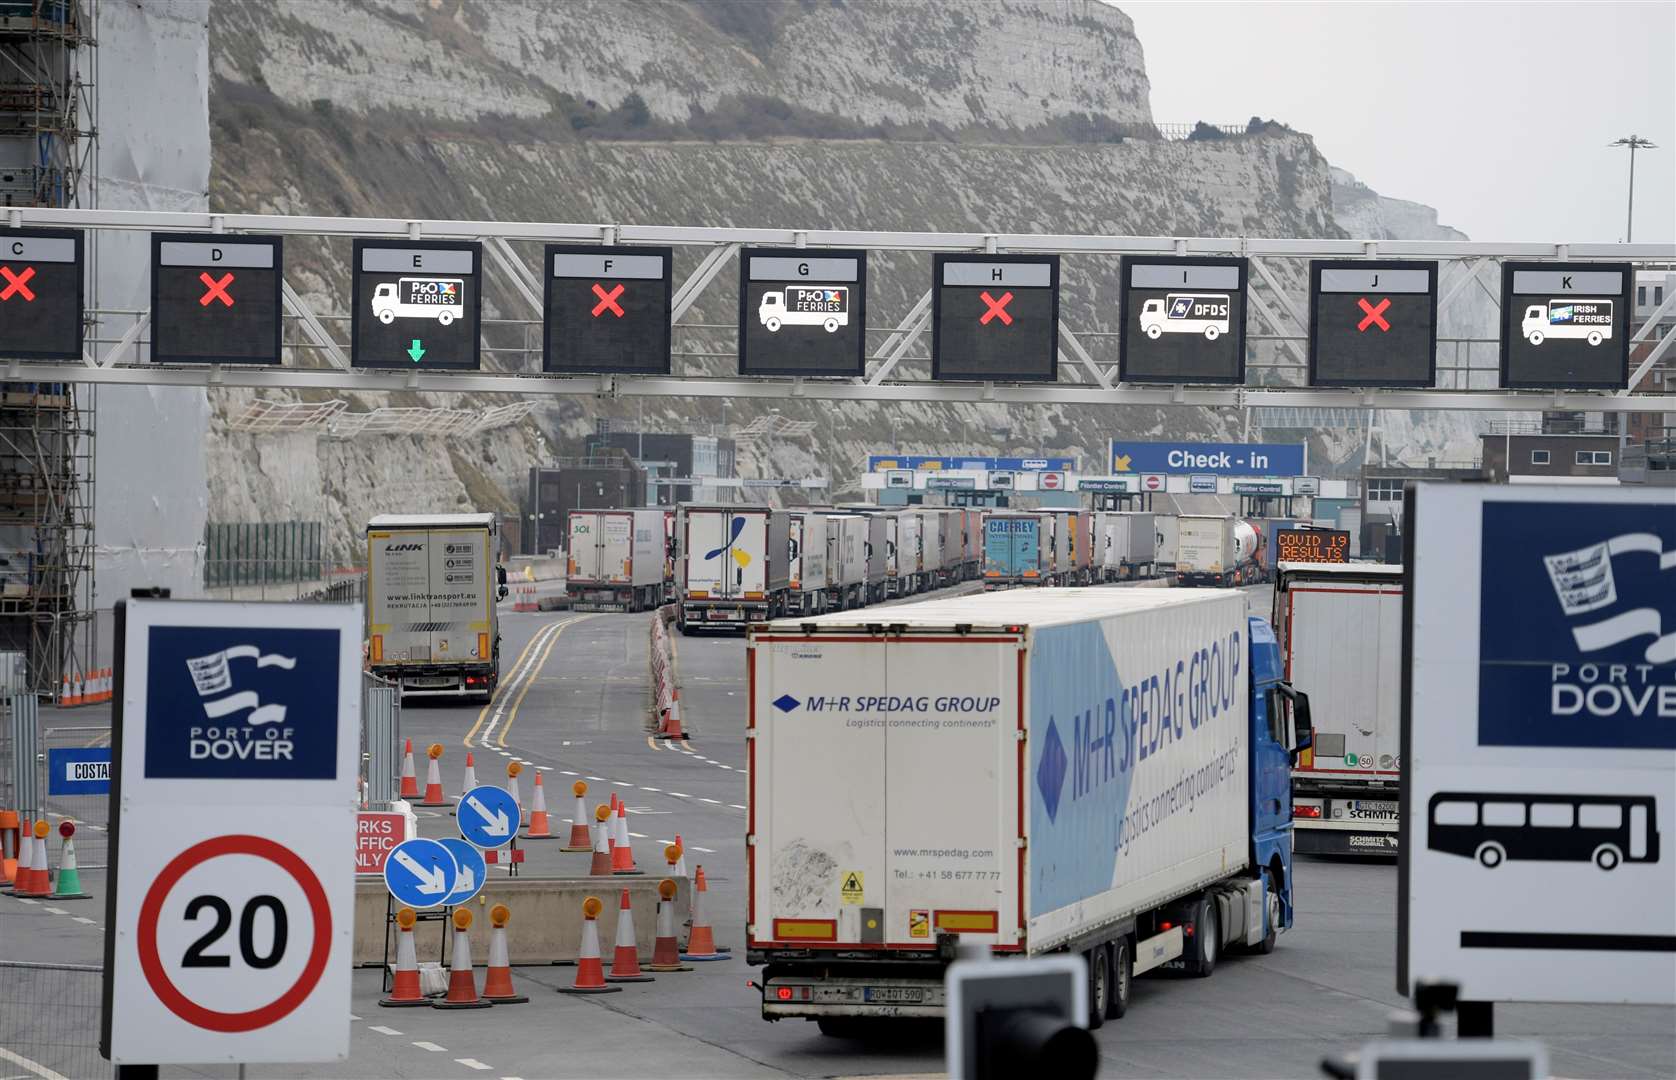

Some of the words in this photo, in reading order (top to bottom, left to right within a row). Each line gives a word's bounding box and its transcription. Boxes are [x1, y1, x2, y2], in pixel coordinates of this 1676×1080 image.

[12, 242, 24, 255] C
[212, 249, 222, 261] D
[413, 255, 422, 267] E
[604, 260, 613, 272] F
[798, 263, 809, 276] G
[992, 269, 1002, 281] H
[1371, 275, 1378, 288] J
[1562, 276, 1572, 289] K
[412, 282, 438, 294] P&O
[411, 294, 455, 304] FERRIES
[798, 290, 823, 301] P&O
[797, 302, 840, 312] FERRIES
[1194, 304, 1227, 316] DFDS
[1167, 450, 1231, 469] Check
[1251, 452, 1268, 469] in
[990, 521, 1034, 533] CAFFREY
[1278, 534, 1320, 546] COVID
[1330, 536, 1347, 547] 19
[1282, 546, 1342, 558] RESULTS
[387, 592, 476, 601] www.linktransport.eu
[1552, 663, 1653, 684] PORT
[807, 696, 850, 712] M+R
[856, 696, 928, 712] SPEDAG
[934, 696, 1000, 712] GROUP
[1073, 698, 1116, 800] M+R
[1120, 660, 1184, 773] SPEDAG
[1189, 631, 1240, 730] GROUP
[846, 719, 885, 728] Logistics
[888, 719, 940, 729] connecting
[191, 727, 253, 740] PORT
[266, 728, 294, 740] OF
[190, 740, 294, 760] DOVER
[1347, 755, 1354, 765] L
[1114, 796, 1149, 856] Logistics
[1151, 769, 1194, 826] connecting
[1350, 811, 1400, 819] SCHMITZ
[356, 820, 392, 833] RKS
[894, 848, 993, 859] www.mrspedag.com
[918, 871, 936, 880] +41
[941, 872, 952, 880] 58
[955, 872, 972, 880] 677
[975, 872, 987, 880] 77
[990, 872, 1000, 880] 77
[182, 895, 288, 970] 20
